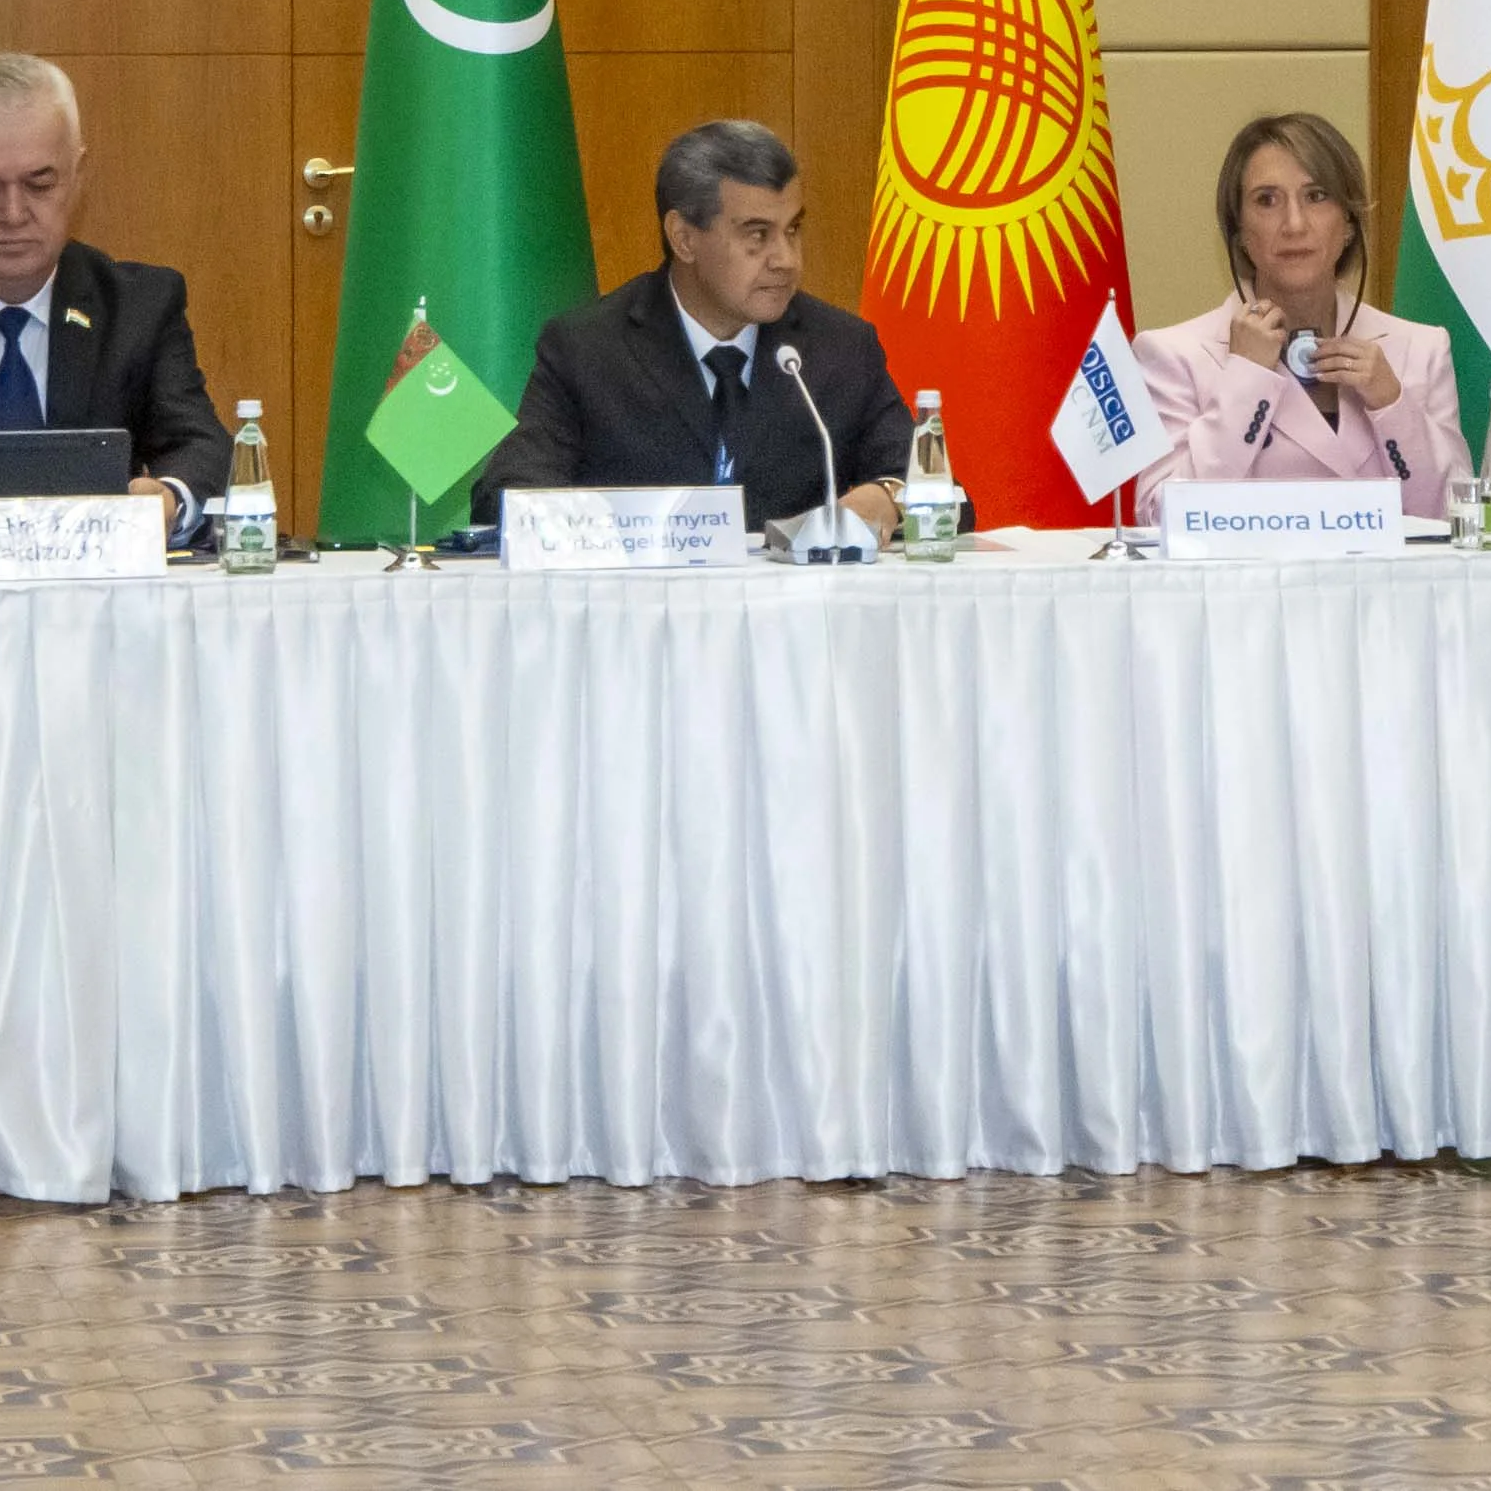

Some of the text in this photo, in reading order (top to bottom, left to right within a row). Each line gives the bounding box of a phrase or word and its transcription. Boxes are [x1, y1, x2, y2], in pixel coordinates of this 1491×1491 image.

[605, 511, 730, 531] Jummyrat
[1185, 509, 1383, 531] Eleonora Lotti
